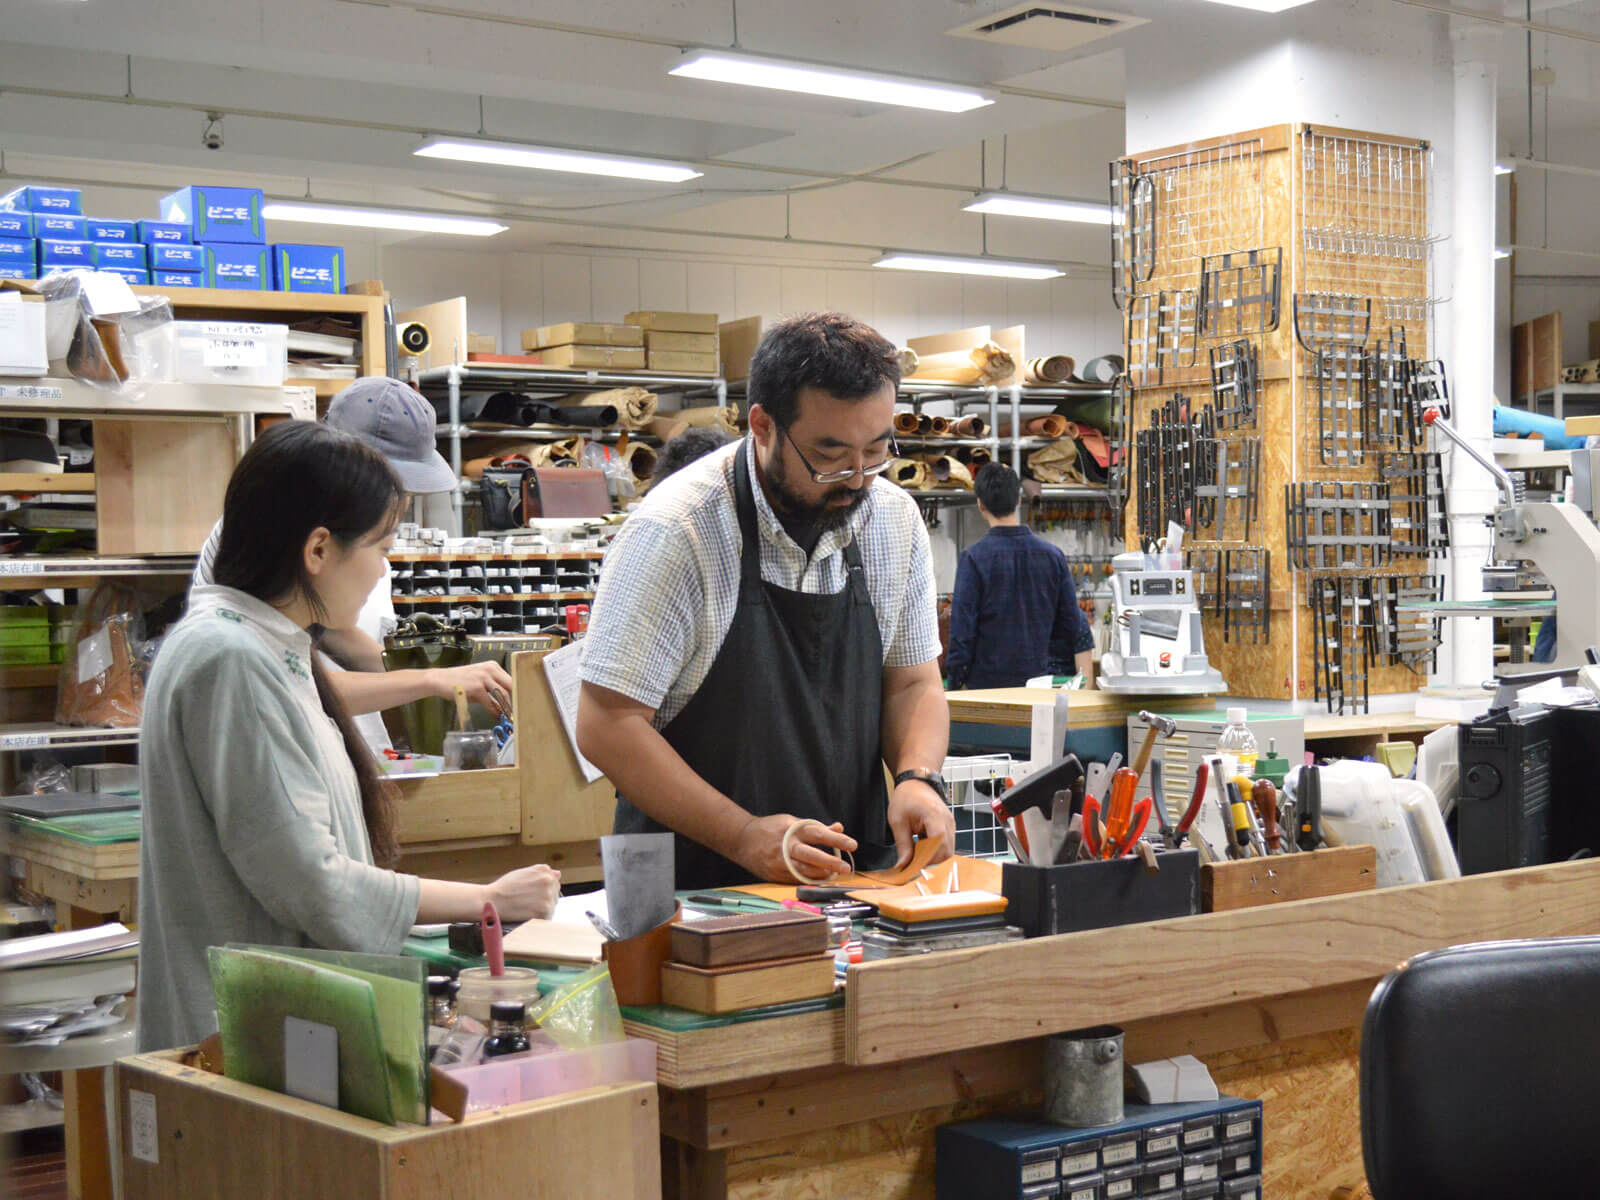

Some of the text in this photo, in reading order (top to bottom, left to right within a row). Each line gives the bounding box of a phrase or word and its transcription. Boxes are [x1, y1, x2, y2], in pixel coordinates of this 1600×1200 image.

[207, 206, 249, 219] ビニモ
[46, 220, 75, 230] ビニモ
[54, 246, 83, 255] ビニモ
[106, 248, 134, 257] ビニモ
[165, 249, 193, 259] ビニモ
[217, 264, 258, 277] ビニモ
[291, 267, 331, 280] ビニモ
[165, 275, 193, 284] ビニモ
